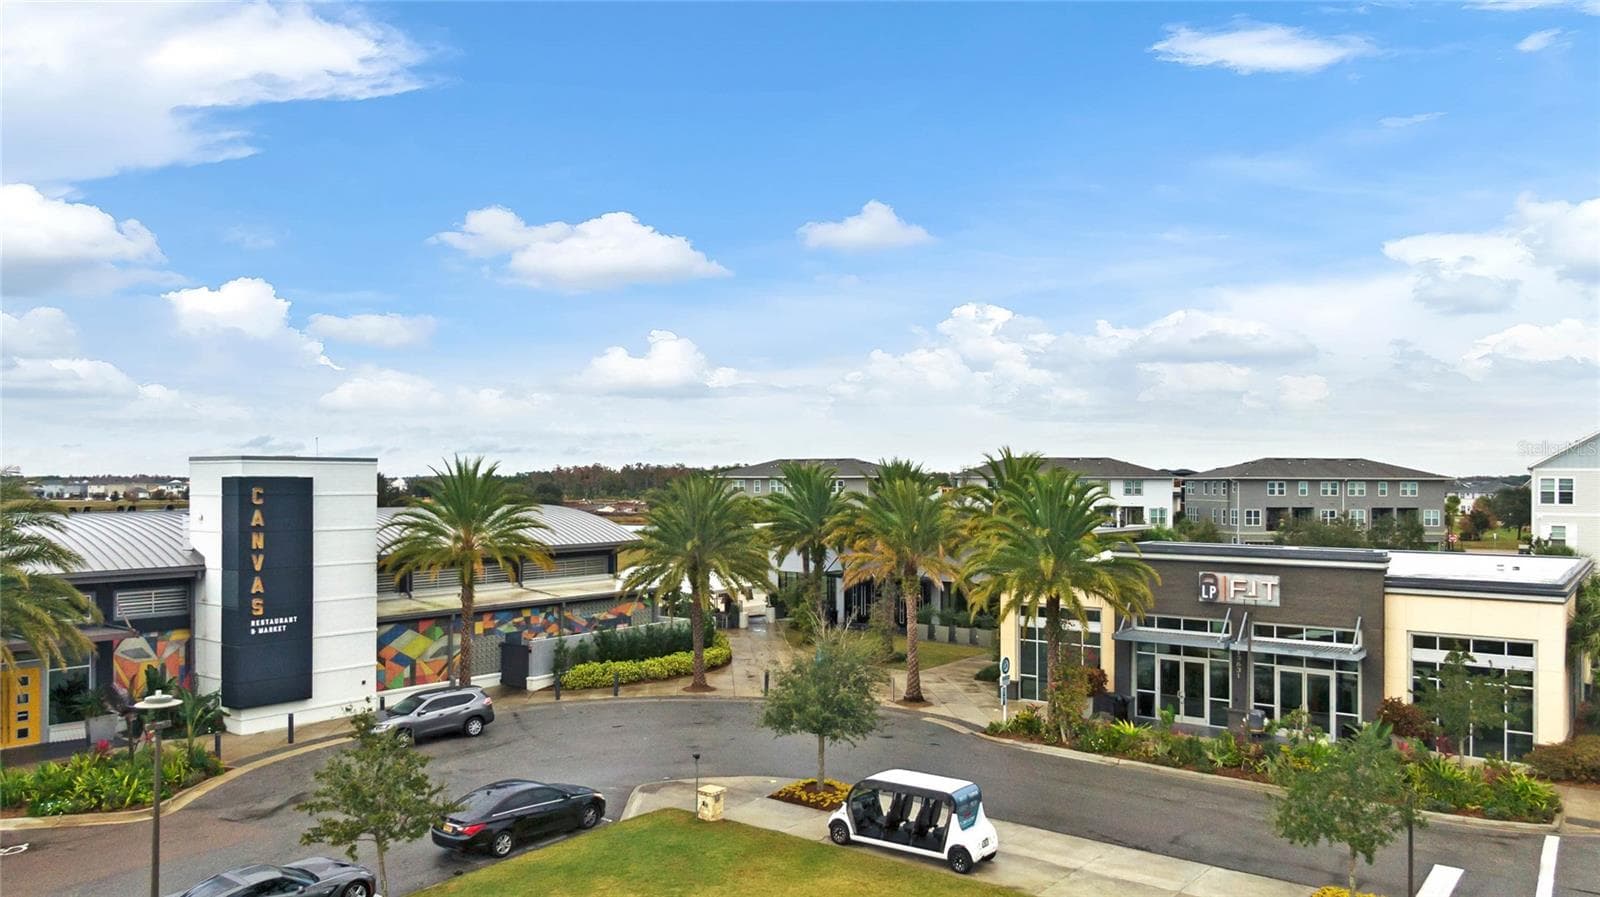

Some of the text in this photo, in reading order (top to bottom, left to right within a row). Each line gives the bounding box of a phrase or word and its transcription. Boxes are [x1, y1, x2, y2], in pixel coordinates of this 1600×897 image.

[251, 487, 265, 616] CANVAS
[1201, 584, 1217, 599] LP
[251, 616, 297, 626] RESTAURANT
[258, 625, 287, 634] MARKET
